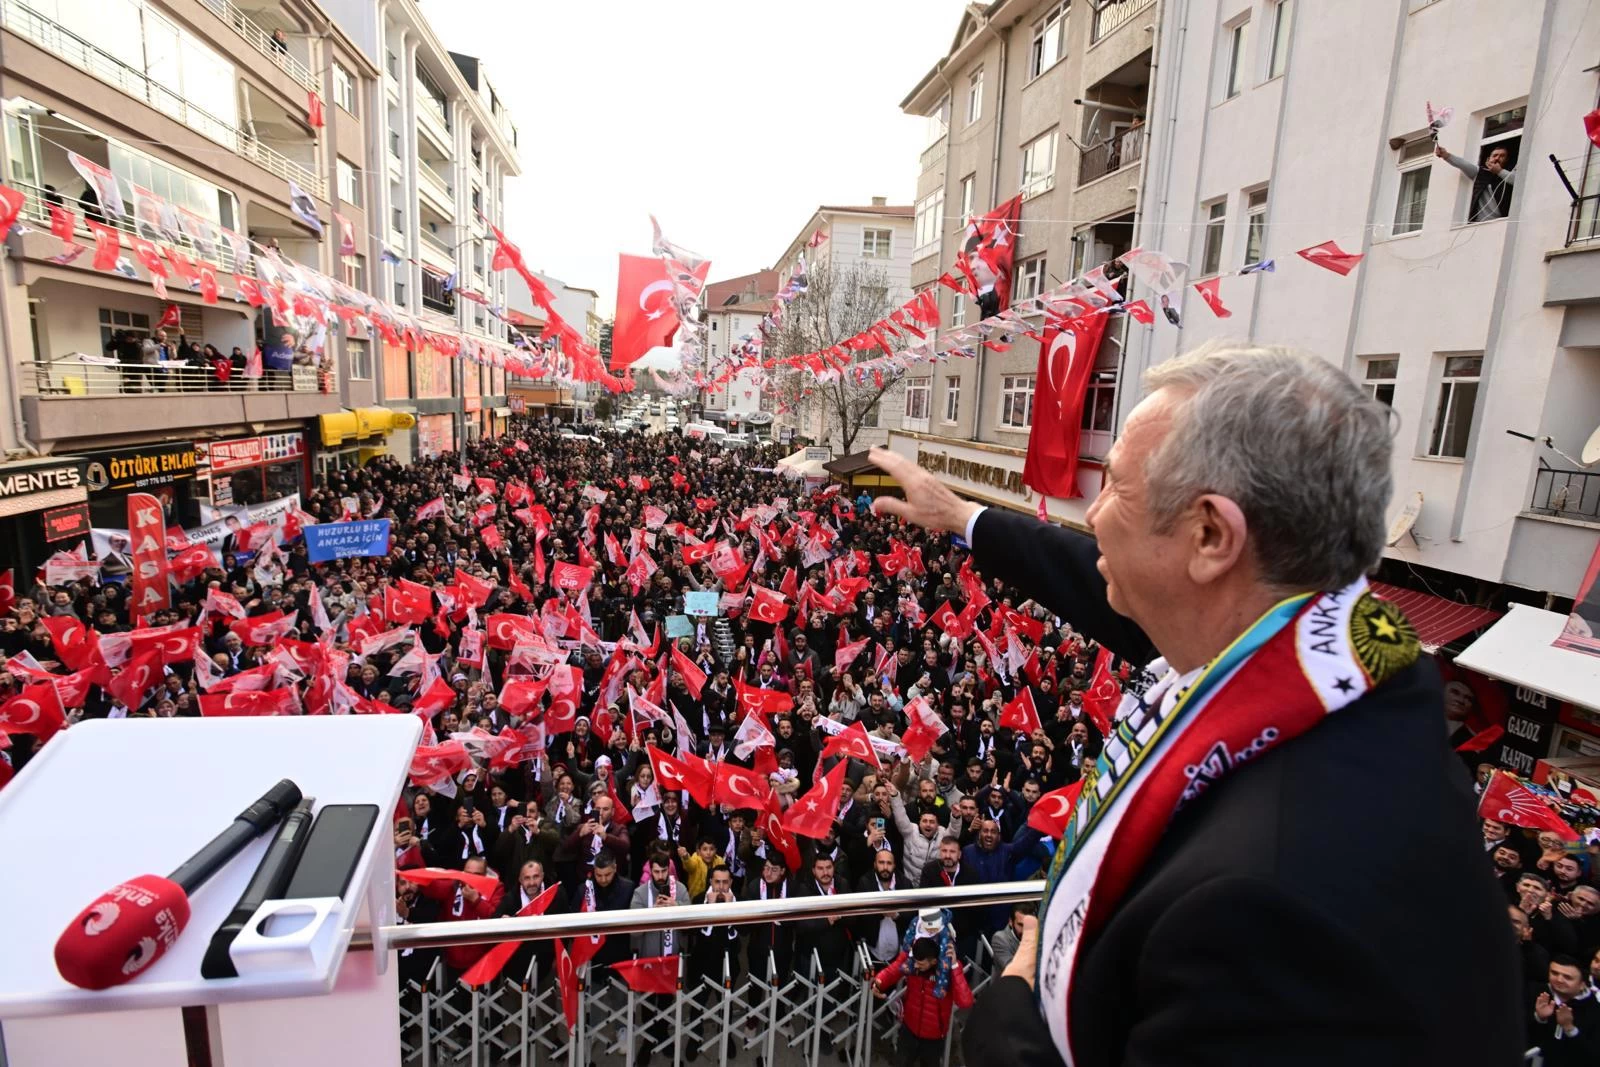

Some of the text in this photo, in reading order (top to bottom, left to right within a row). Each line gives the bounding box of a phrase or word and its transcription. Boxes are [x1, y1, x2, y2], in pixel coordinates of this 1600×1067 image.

[110, 456, 159, 479] ÖZTÜRK
[161, 450, 197, 472] EMLAK
[0, 467, 81, 497] MENTEŞ
[317, 532, 383, 548] ANKARA İÇİN
[318, 522, 380, 537] HUZURLU BİR
[560, 578, 578, 587] CHP
[1310, 588, 1345, 656] ANKA
[1515, 685, 1547, 709] COLA
[1507, 715, 1541, 742] GAZOZ
[1500, 744, 1534, 774] KAHVE
